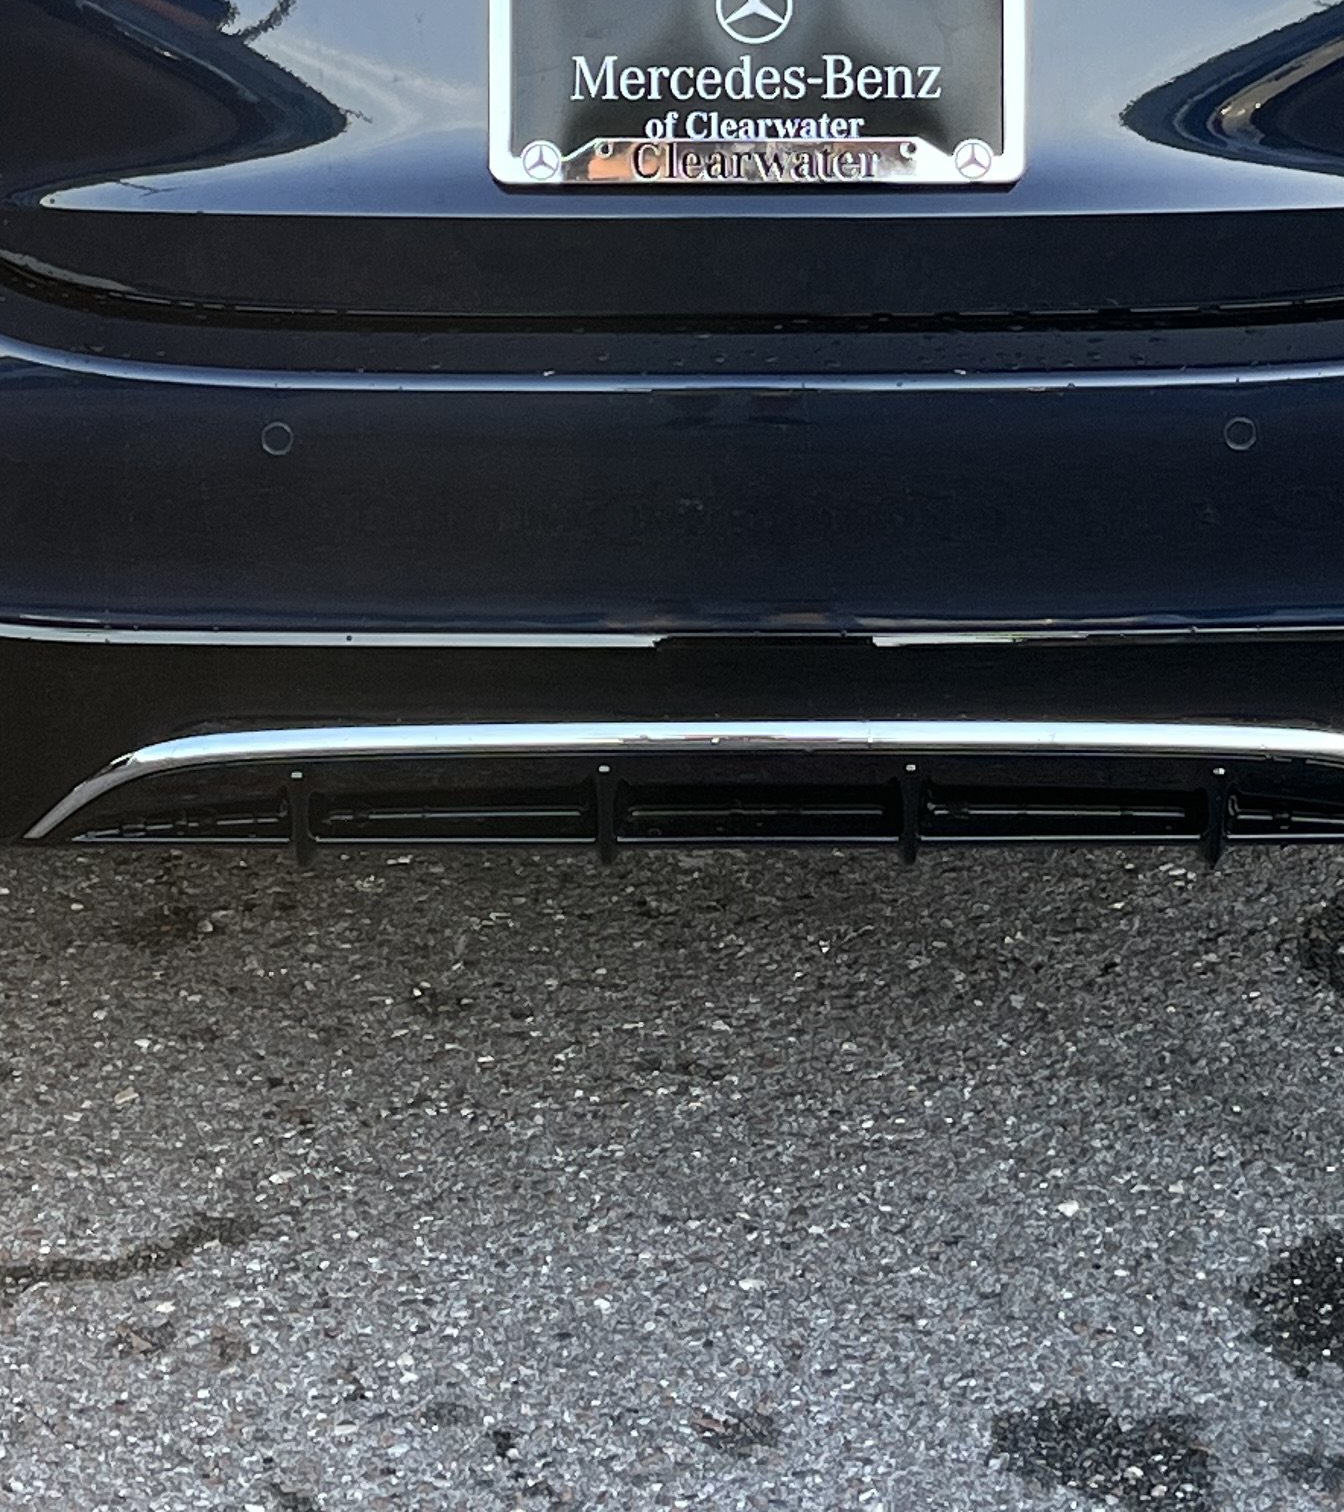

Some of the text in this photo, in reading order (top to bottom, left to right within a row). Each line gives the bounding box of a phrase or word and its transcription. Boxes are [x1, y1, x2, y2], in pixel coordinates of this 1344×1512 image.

[569, 54, 943, 101] Mercedes-Benz
[644, 111, 865, 139] of Clearwater
[632, 142, 880, 180] Clearwater
